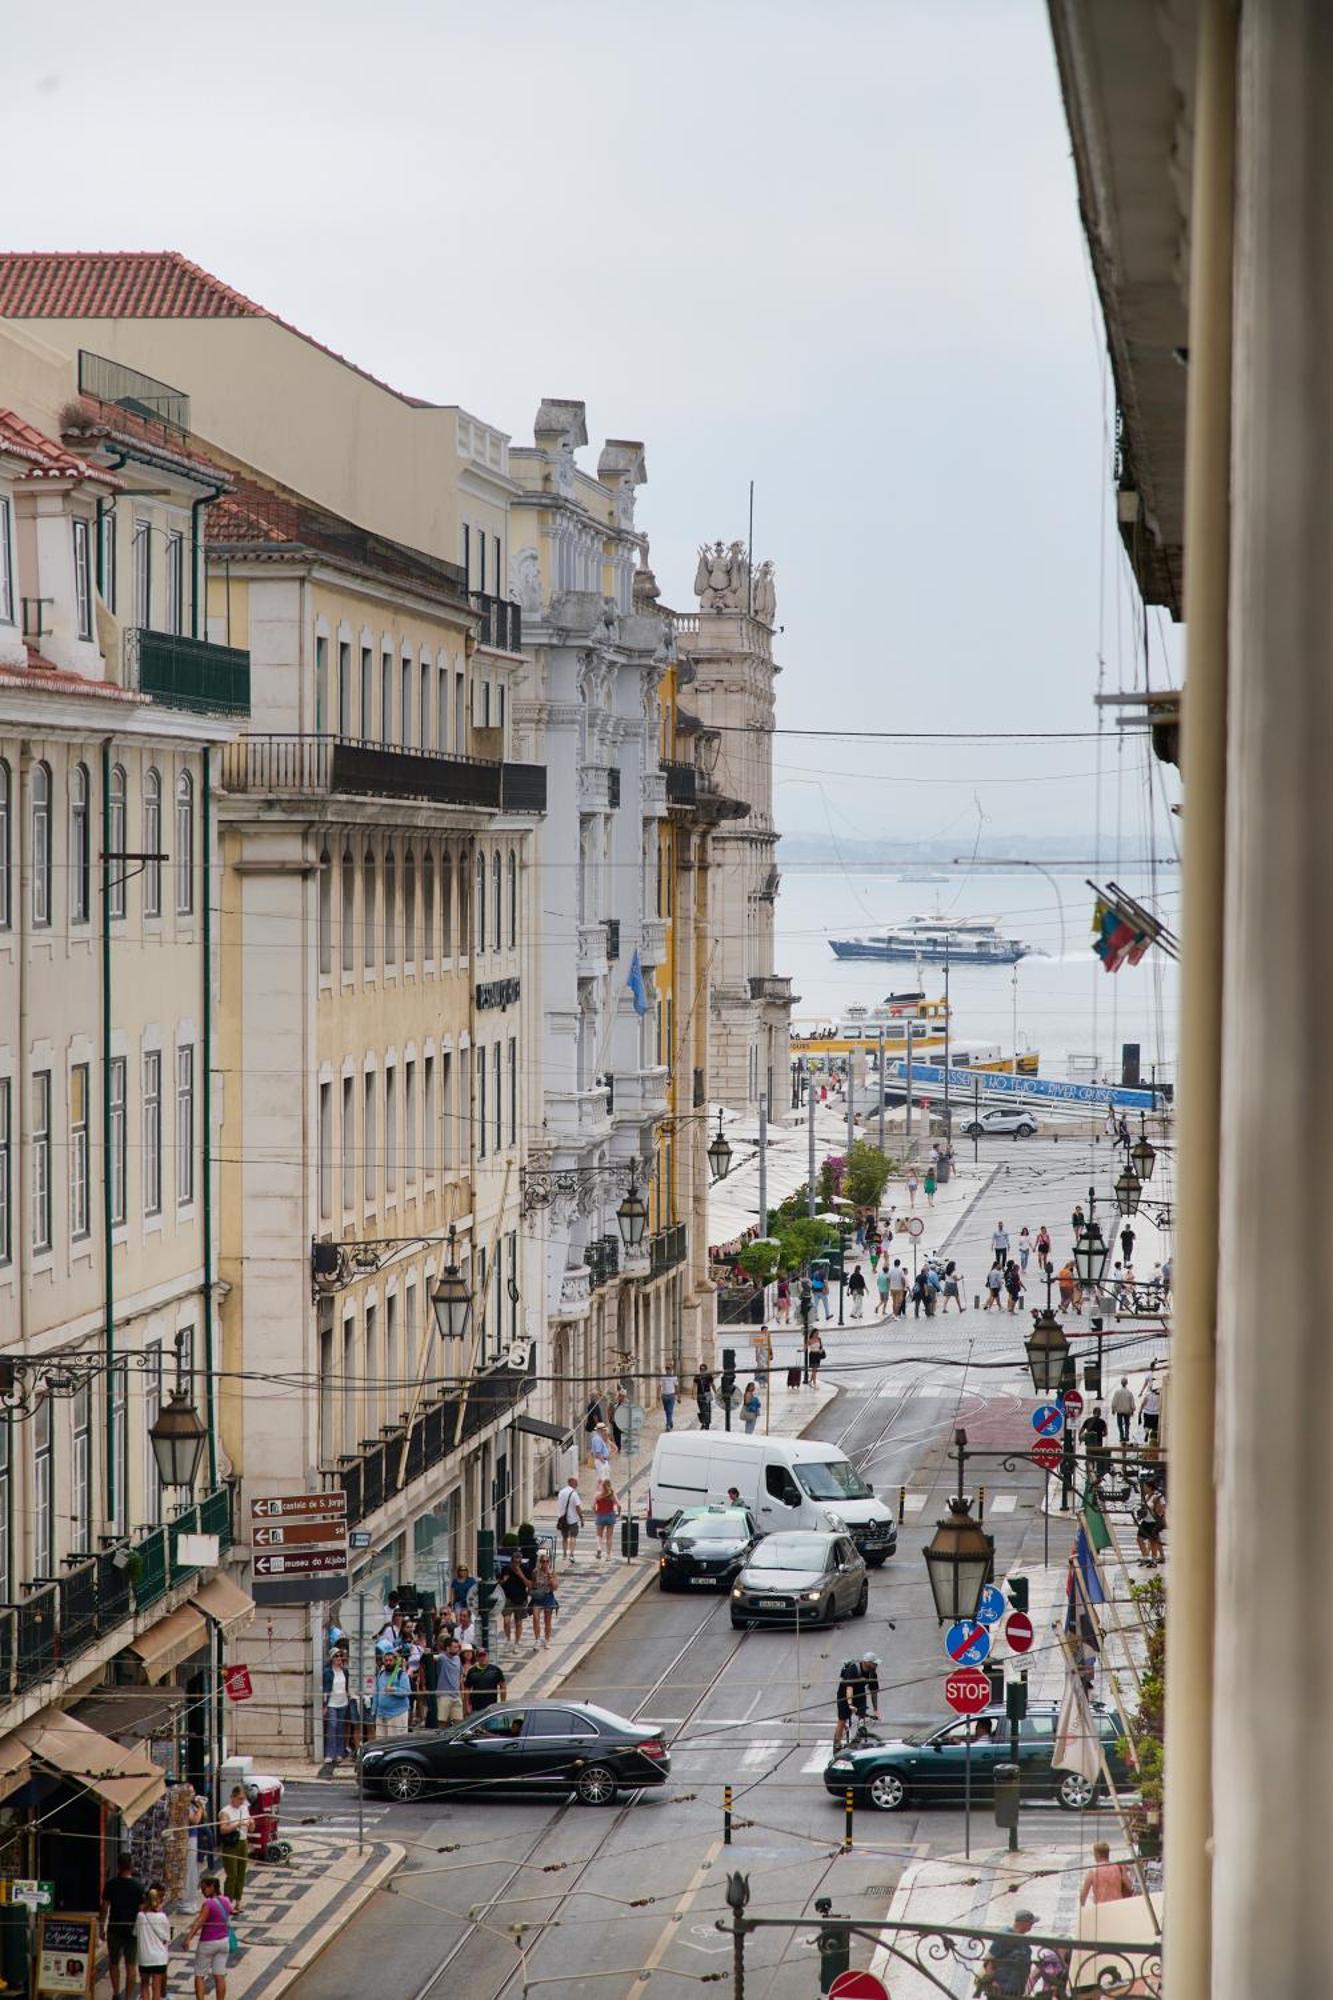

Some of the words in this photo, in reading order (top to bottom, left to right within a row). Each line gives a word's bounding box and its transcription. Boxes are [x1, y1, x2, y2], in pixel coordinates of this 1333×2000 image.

[989, 1076, 1007, 1089] NO
[1048, 1084, 1077, 1098] RIVER
[282, 1501, 307, 1510] castelo
[312, 1558, 321, 1566] do
[947, 1683, 989, 1699] STOP
